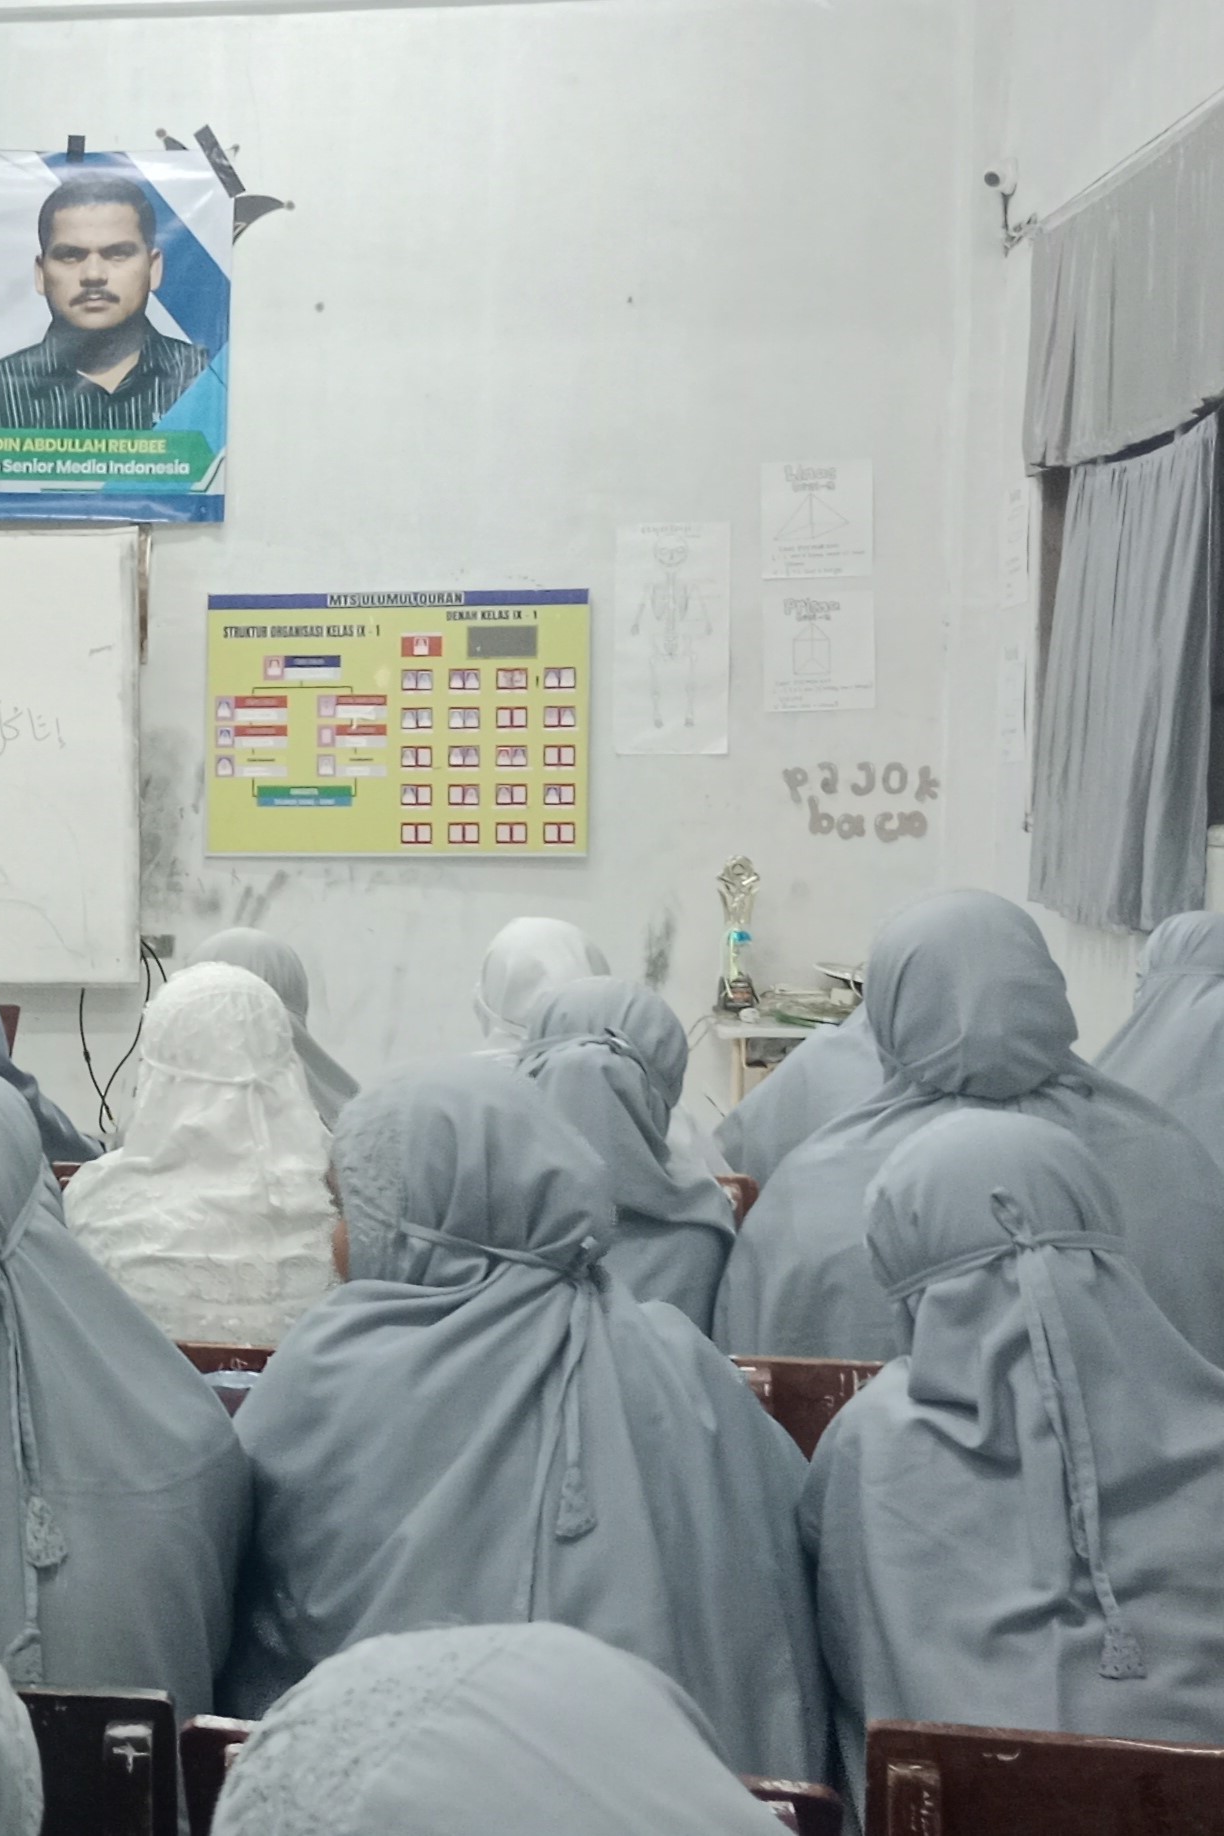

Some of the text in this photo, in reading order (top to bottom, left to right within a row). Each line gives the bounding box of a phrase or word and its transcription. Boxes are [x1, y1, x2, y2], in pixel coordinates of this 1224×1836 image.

[24, 437, 106, 453] ABDULLAH
[108, 438, 167, 454] REUBEE
[2, 458, 54, 474] Senior
[56, 458, 107, 475] Media
[109, 458, 190, 475] Indonesia
[329, 591, 463, 606] MTS ULUMUL QURAN
[480, 609, 510, 621] KELAS
[223, 625, 268, 639] STRUKTUR
[270, 624, 324, 639] ORGANISASI
[326, 624, 354, 638] KELAS
